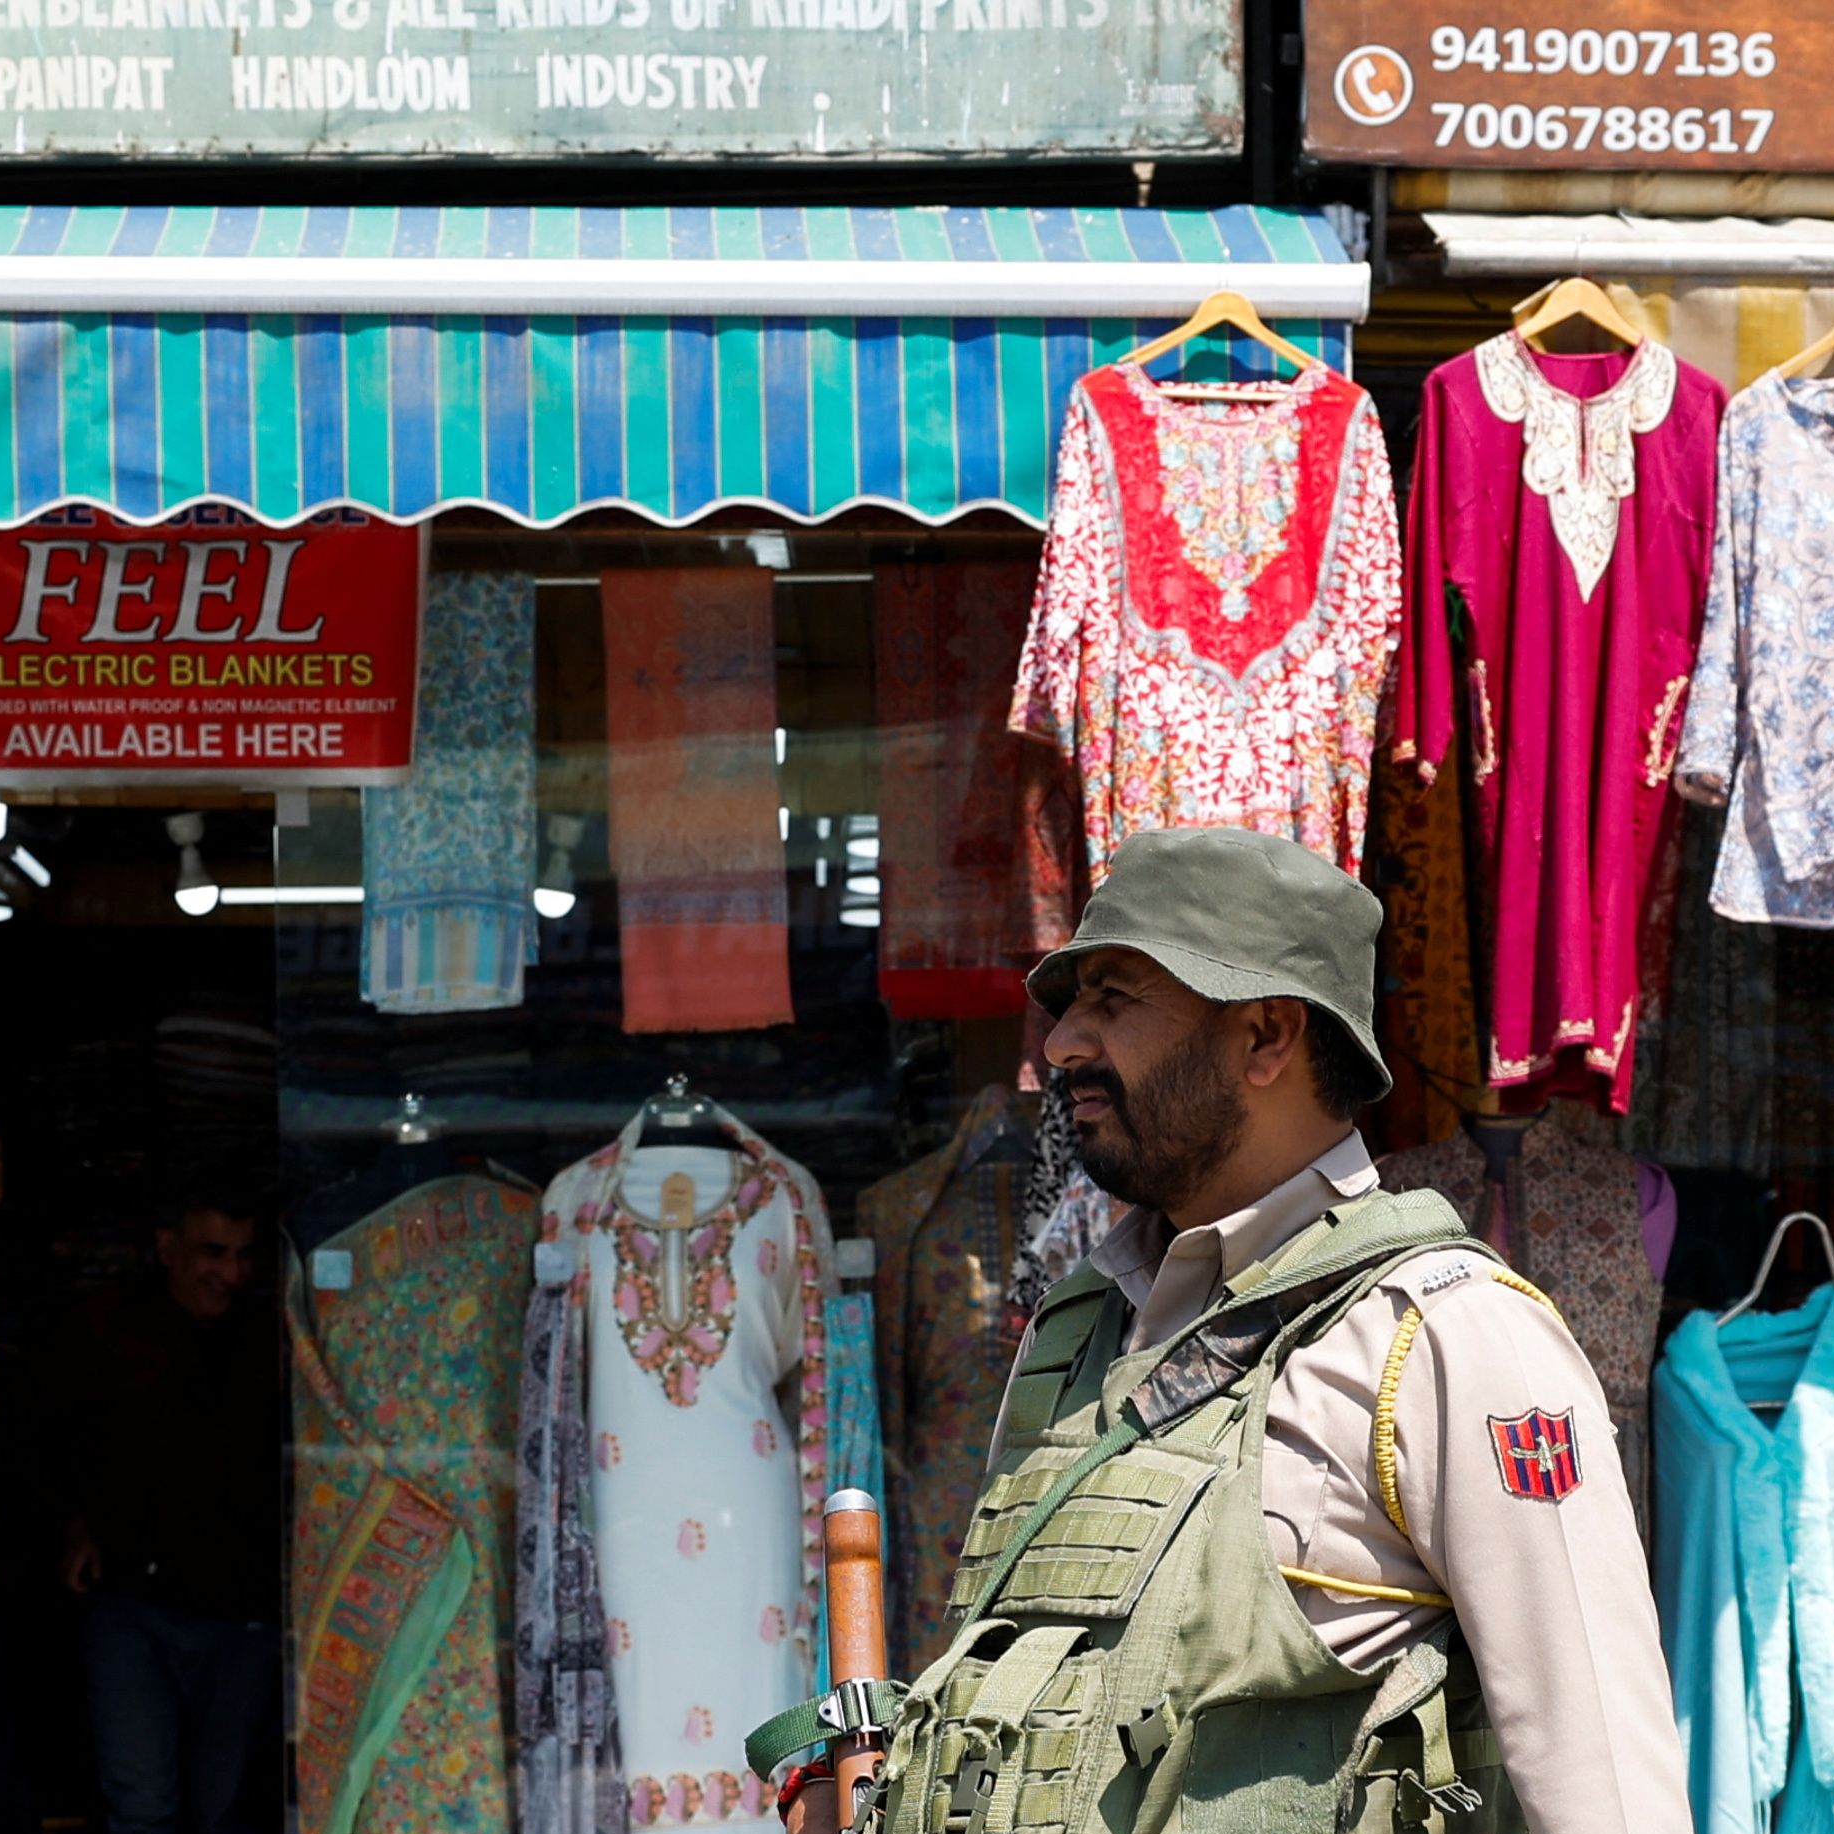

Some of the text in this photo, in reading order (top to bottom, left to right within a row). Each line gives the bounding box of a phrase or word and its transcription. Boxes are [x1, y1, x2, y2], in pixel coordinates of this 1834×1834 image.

[1430, 26, 1776, 78] 9419007136
[232, 54, 471, 112] HANDLOOM
[535, 53, 767, 110] INDUSTRY
[1430, 101, 1775, 154] 7006788617
[3, 539, 325, 644] FEEL
[169, 654, 374, 687] BLANKETS
[30, 699, 67, 713] WITH
[71, 699, 126, 713] WATER
[129, 699, 184, 713] PROOF
[187, 699, 199, 713] &
[202, 699, 237, 713] NON
[240, 698, 320, 713] MAGNETIC
[325, 698, 397, 713] ELEMENT
[3, 723, 344, 758] AVAILABLE HERE
